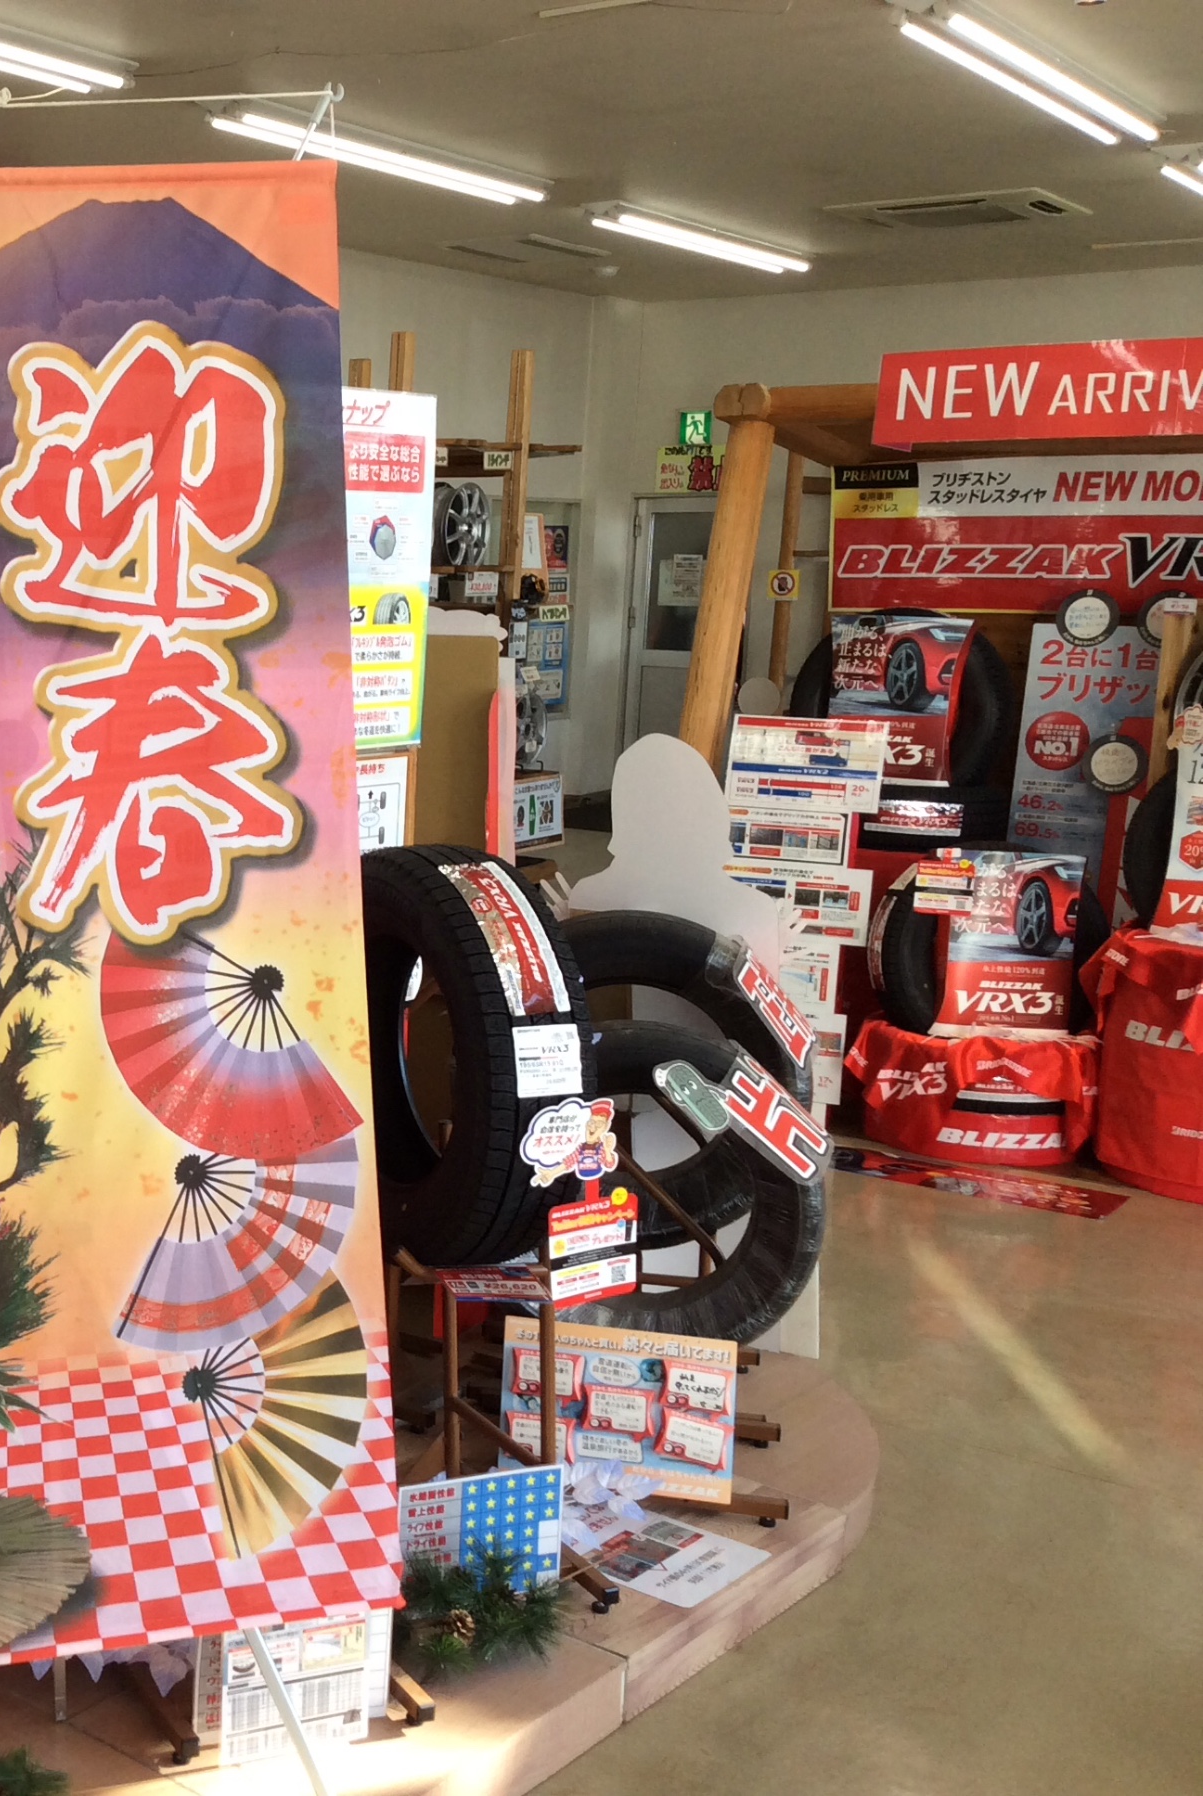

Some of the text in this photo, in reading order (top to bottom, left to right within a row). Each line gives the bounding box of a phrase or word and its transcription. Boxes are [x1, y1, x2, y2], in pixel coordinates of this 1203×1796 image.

[895, 361, 1203, 421] NEW ARRIV
[342, 398, 391, 426] ナップ
[349, 443, 421, 463] より安全な総合
[348, 463, 421, 484] 性能で選ぶなら
[841, 469, 910, 482] PREMIUM
[932, 470, 1012, 488] ブリヂストン
[929, 487, 1047, 505] スタッドレスタイヤ
[1052, 469, 1203, 503] NEW MO
[853, 503, 899, 514] スタッドレス
[837, 543, 1125, 580] BLIZZAK
[836, 622, 886, 644] 曲がる、
[838, 642, 893, 661] 止まるは、
[1039, 640, 1159, 670] 2台に1台
[836, 658, 881, 676] 新たな
[1034, 737, 1080, 757] NO.1
[356, 763, 386, 776] 長持ち
[478, 877, 520, 919] VRX3
[979, 979, 1044, 991] BLIZZAK
[955, 990, 1056, 1015] VRX3
[584, 1200, 611, 1213] VRX3
